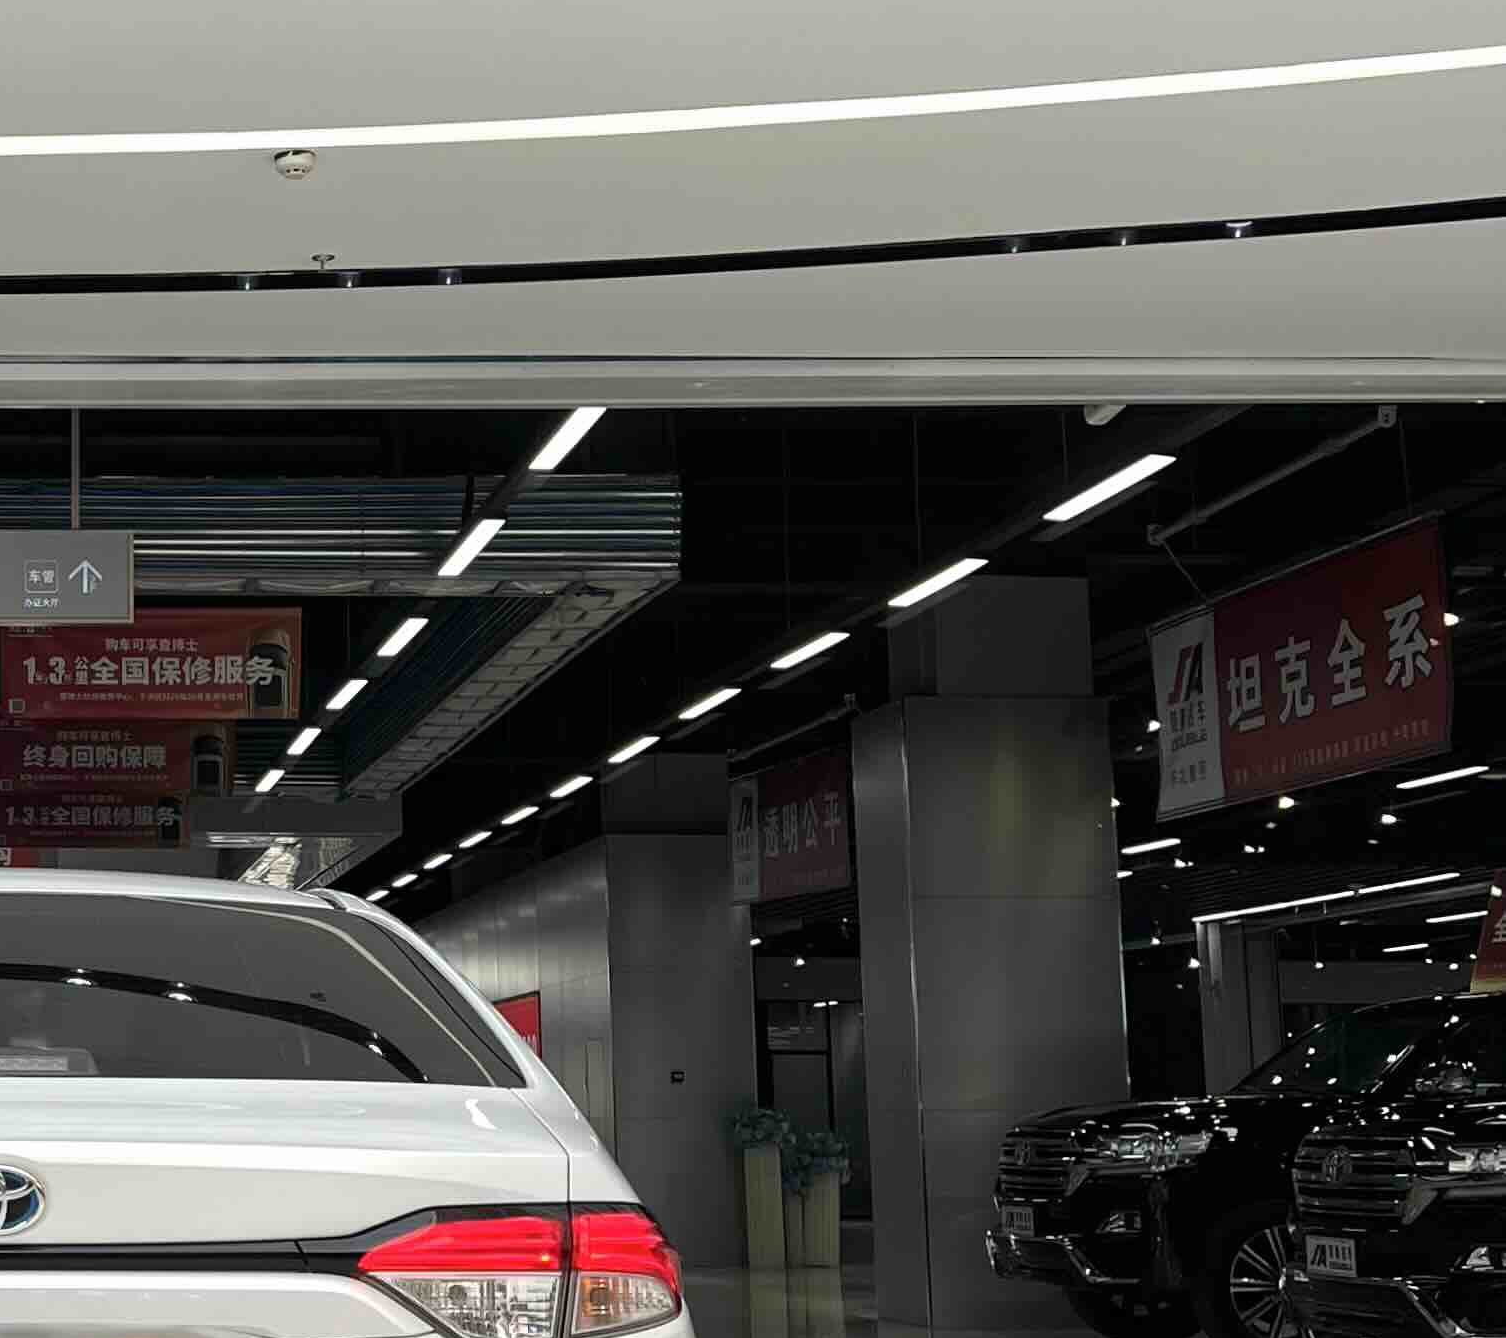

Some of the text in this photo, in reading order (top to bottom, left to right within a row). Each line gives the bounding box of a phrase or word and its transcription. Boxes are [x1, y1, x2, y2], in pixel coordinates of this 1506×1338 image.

[28, 568, 55, 583] 车管
[1227, 593, 1434, 734] 坦克全系
[22, 744, 166, 769] 终身回购保障
[760, 789, 842, 857] 透明公平
